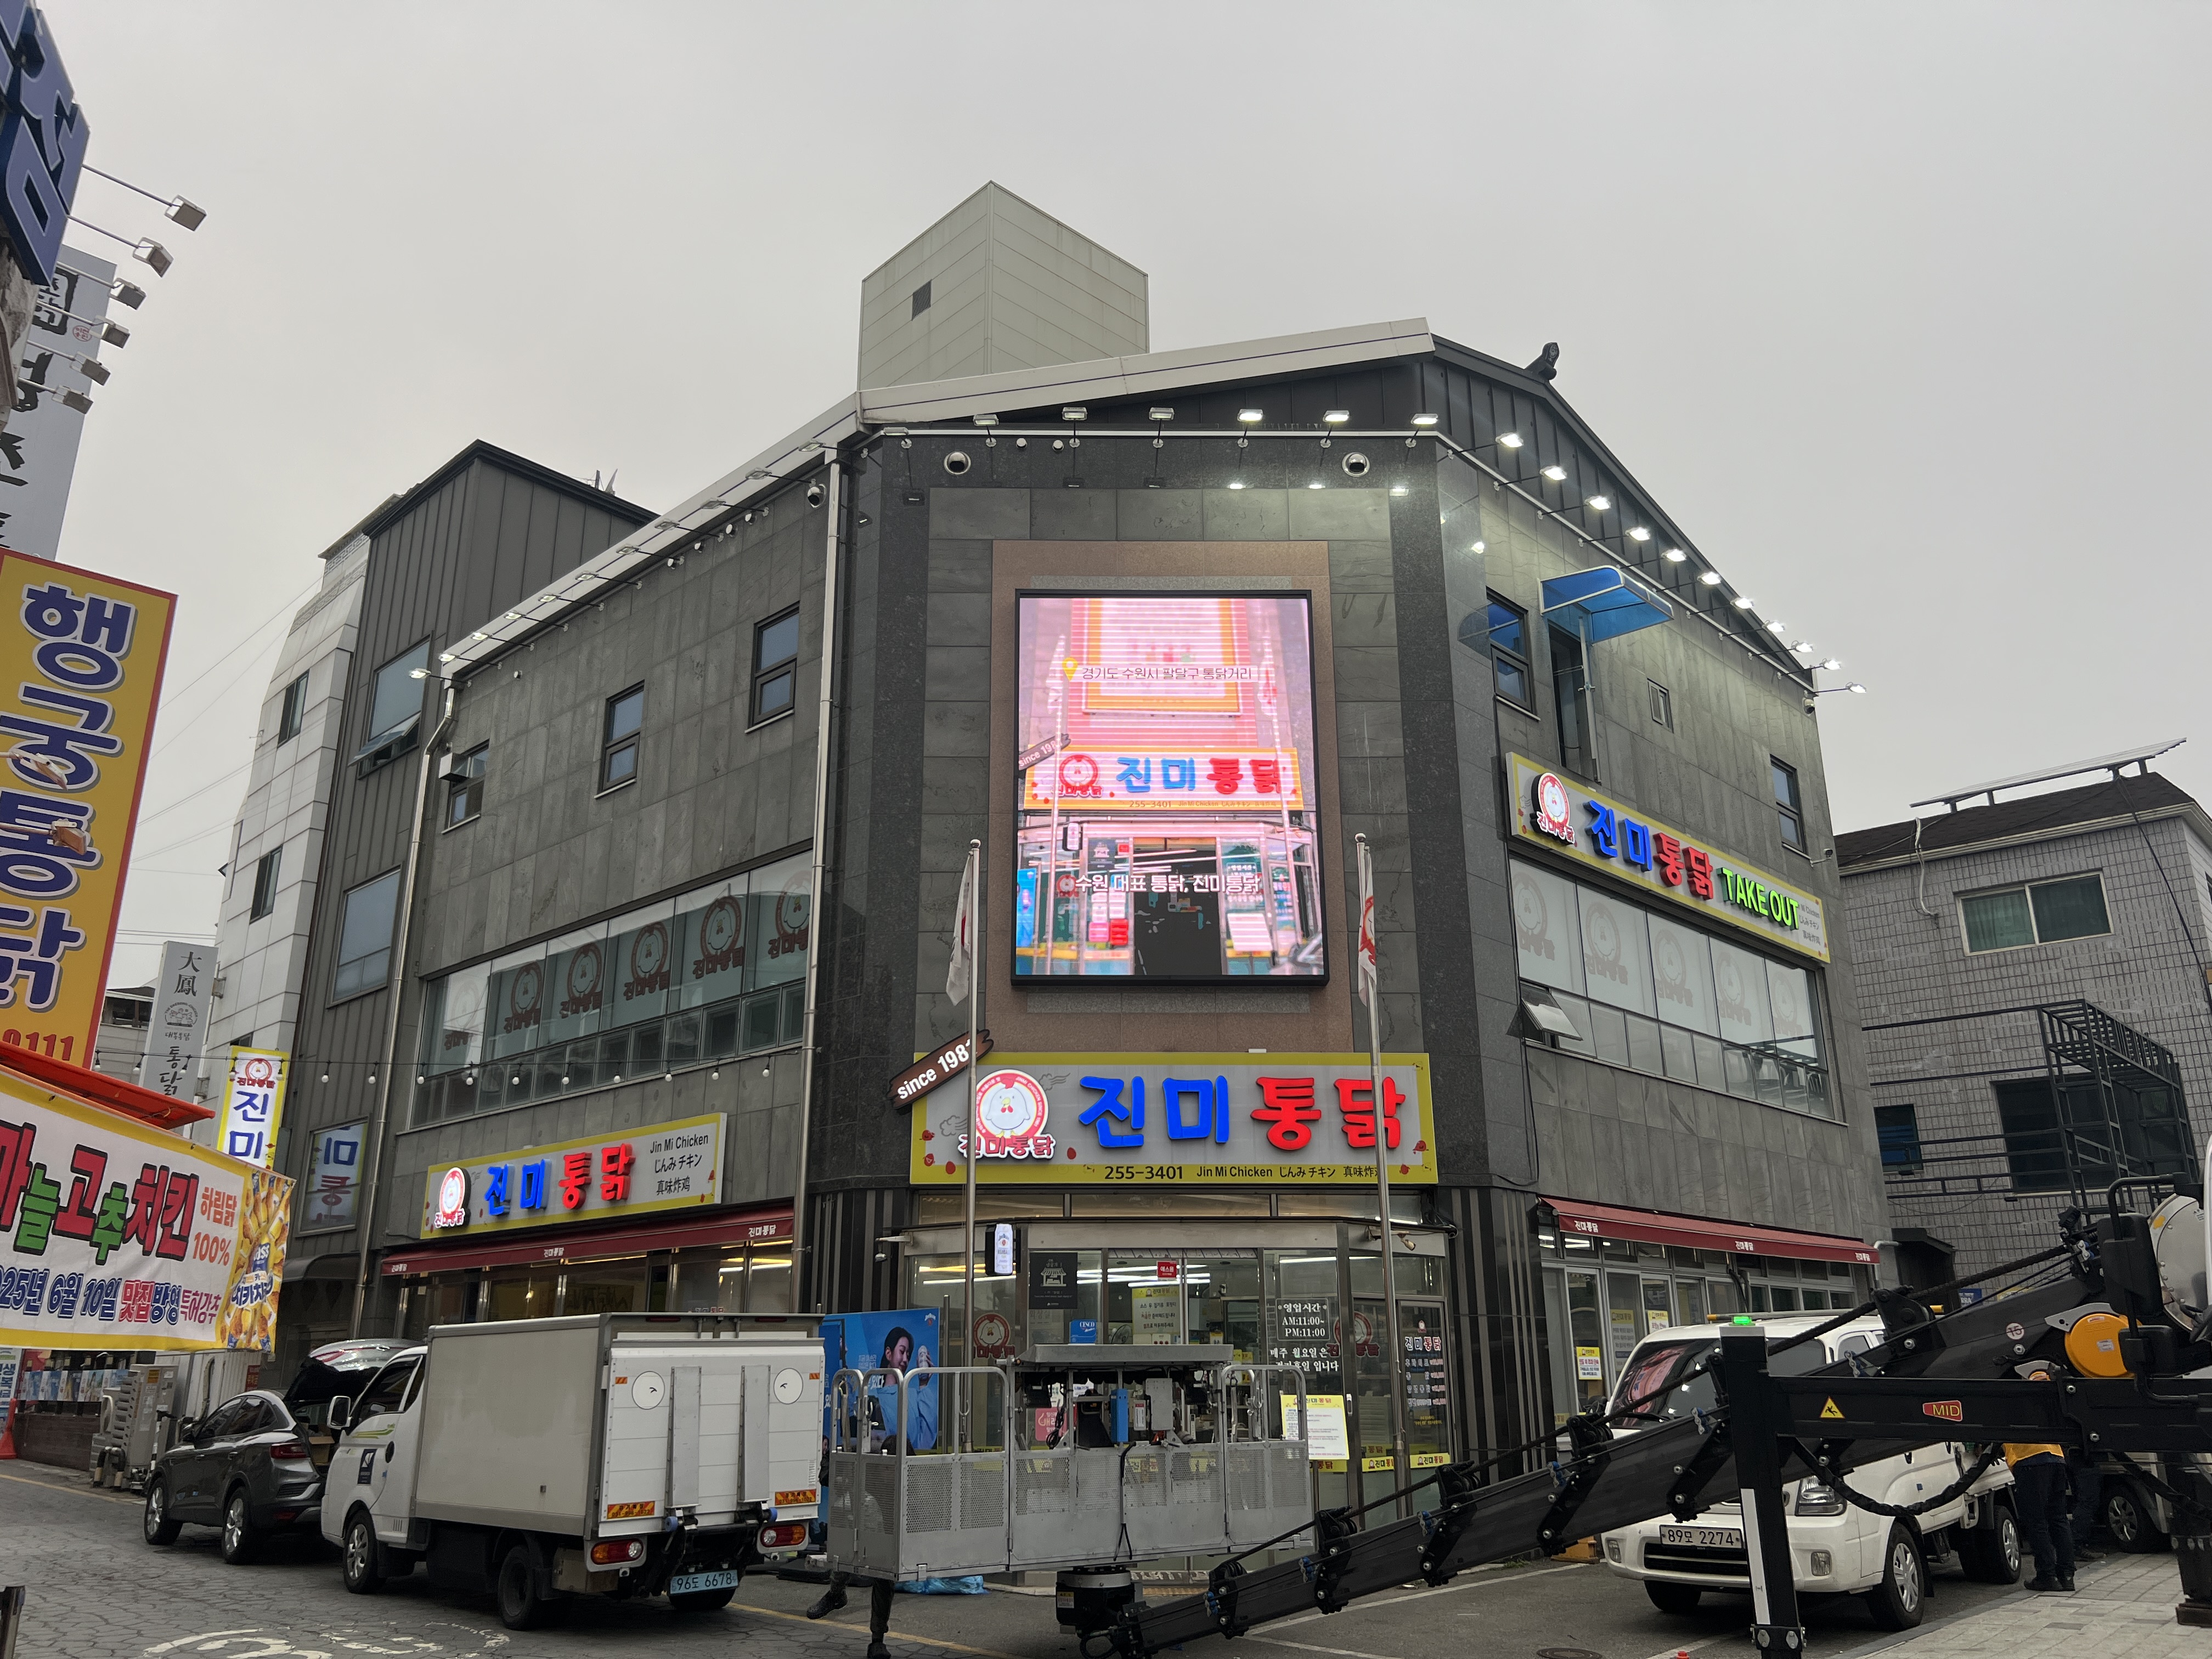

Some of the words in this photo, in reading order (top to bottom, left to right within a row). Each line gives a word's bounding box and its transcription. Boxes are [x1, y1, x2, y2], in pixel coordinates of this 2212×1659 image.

[1082, 668, 1118, 679] 경기도
[1122, 668, 1158, 679] 수원시
[1163, 668, 1198, 679] 팔달구
[1203, 667, 1251, 680] 통닭거리
[1019, 752, 1040, 767] since
[1041, 741, 1062, 754] 198
[1116, 757, 1281, 794] 진미통닭
[0, 582, 136, 1011] 행궁통닭
[1537, 811, 1575, 843] 진미통닭
[1584, 800, 1714, 900] 진미통닭
[1075, 875, 1108, 892] 수원
[1114, 875, 1147, 892] 대표
[1150, 875, 1189, 893] 통닭,
[1193, 875, 1260, 893] 진미통닭
[1718, 867, 1768, 917] TAKE
[1768, 890, 1799, 930] OUT
[174, 951, 202, 997] 大鳳
[159, 1046, 183, 1096] 통닭
[897, 1068, 937, 1099] since
[1079, 1075, 1406, 1151] 진미통닭
[229, 1091, 269, 1159] 진미
[650, 1141, 662, 1153] Jin
[664, 1138, 674, 1151] Mi
[676, 1133, 708, 1149] Chicken
[655, 1156, 676, 1173] じんみ
[679, 1153, 702, 1170] チキン
[1105, 1166, 1183, 1180] 255-3401
[1197, 1167, 1212, 1177] Jin
[1215, 1167, 1227, 1176] Mi
[1229, 1166, 1272, 1177] Chicken
[1280, 1167, 1306, 1177] じんみ
[1308, 1166, 1336, 1177] チキン
[484, 1143, 636, 1216] 진미통닭
[201, 1186, 237, 1227] 하림닭
[748, 1224, 777, 1237] 진미통닭
[1574, 1220, 1599, 1234] 진미통닭
[193, 1232, 232, 1266] 100%
[544, 1247, 564, 1257] 진미통닭
[1735, 1240, 1754, 1251] 진미통닭
[1855, 1252, 1870, 1261] 진미통닭
[48, 1272, 83, 1319] 6월
[81, 1278, 122, 1321] 10일
[1283, 1303, 1321, 1313] 영업시간
[1282, 1317, 1325, 1325] AM:11:00~
[1285, 1328, 1325, 1337] PM:11:00
[2007, 1325, 2023, 1338] 15
[1326, 1343, 1380, 1358] 진통닭
[1405, 1336, 1441, 1351] 진미통닭
[974, 1344, 1014, 1359] 미통닭
[1270, 1347, 1288, 1358] 매주
[1292, 1347, 1317, 1358] 월요일
[1319, 1347, 1328, 1358] 은
[1313, 1361, 1339, 1372] 입니다
[1933, 1404, 1960, 1417] MID
[1423, 1455, 1443, 1465] 진미통닭
[1667, 1530, 1694, 1544] 89모
[1699, 1530, 1734, 1545] 2274
[676, 1577, 699, 1590] 96도
[704, 1572, 732, 1588] 6678
